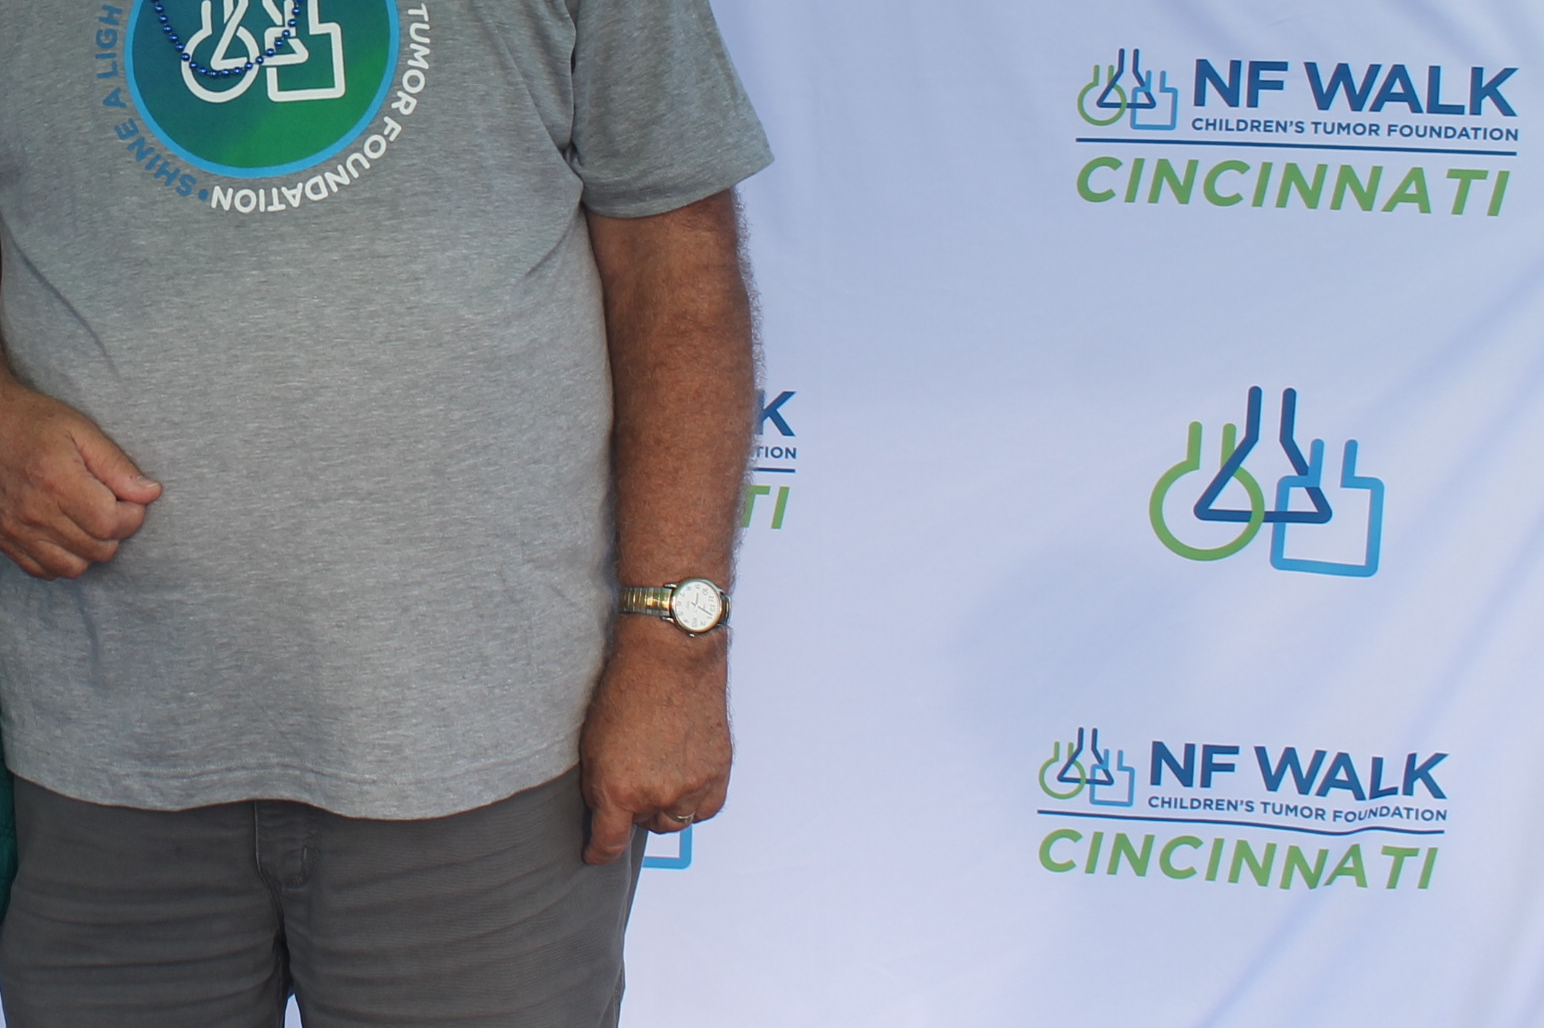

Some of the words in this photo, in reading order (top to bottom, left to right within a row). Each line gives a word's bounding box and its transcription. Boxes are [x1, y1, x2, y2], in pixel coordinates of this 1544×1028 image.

[391, 2, 431, 116] TUMOR
[1193, 58, 1289, 108] NF
[1304, 61, 1520, 117] WALK
[102, 87, 126, 110] A
[115, 117, 198, 198] SHINE
[1191, 117, 1305, 134] CHILDREN'S
[1310, 121, 1381, 137] TUMOR
[1387, 123, 1519, 142] FOUNDATION
[211, 115, 402, 213] FOUNDATION
[1076, 156, 1511, 217] CINCINNATI
[1149, 740, 1240, 789] NF
[1253, 745, 1450, 801] WALK
[1147, 795, 1255, 814] CHILDREN'S
[1259, 801, 1326, 821] TUMOR
[1332, 805, 1448, 824] FOUNDATION
[1038, 828, 1439, 890] CINCINNATI
